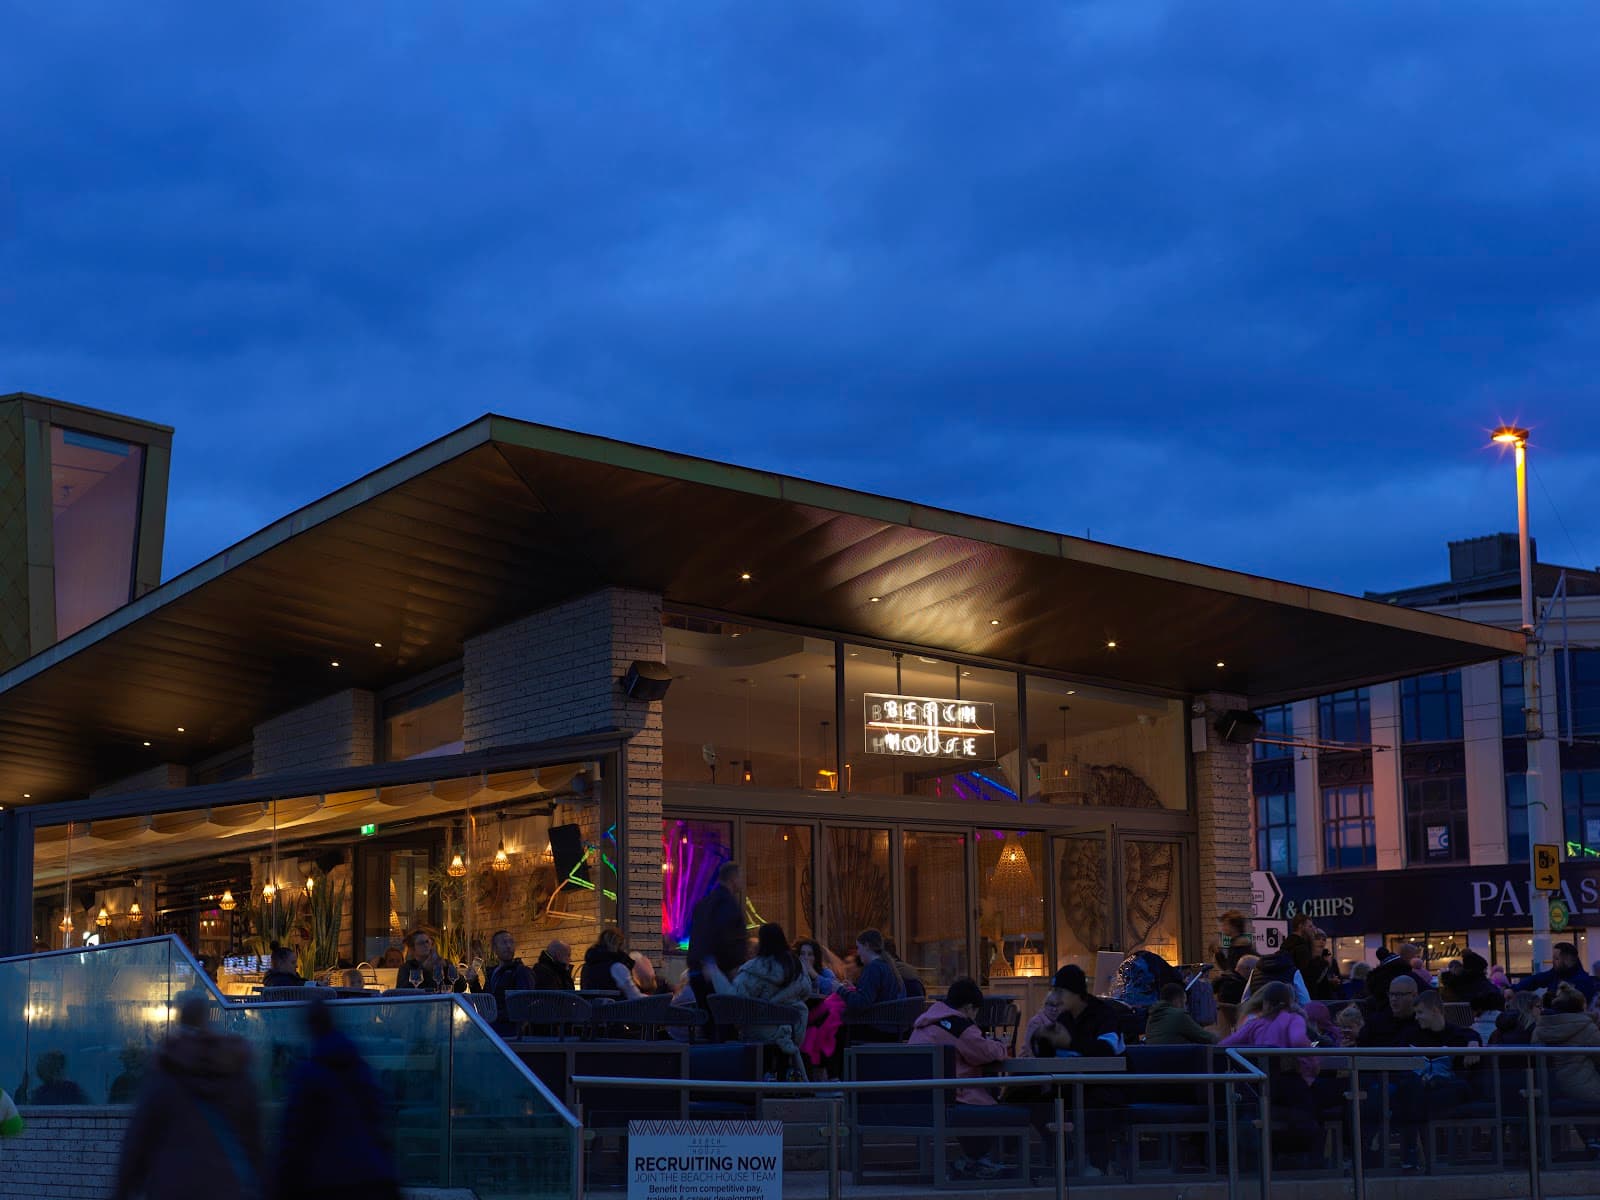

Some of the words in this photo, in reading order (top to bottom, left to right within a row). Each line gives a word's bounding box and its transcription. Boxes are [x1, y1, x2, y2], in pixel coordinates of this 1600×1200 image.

[883, 700, 976, 723] BEACH
[883, 731, 977, 756] HOUSE
[1286, 900, 1298, 919] &
[1302, 896, 1355, 918] CHIPS
[635, 1156, 733, 1171] RECRUITING
[738, 1156, 777, 1171] NOW
[634, 1172, 657, 1182] JOIN
[660, 1172, 678, 1182] THE
[680, 1172, 713, 1182] BEACH
[716, 1171, 749, 1181] HOUSE
[751, 1171, 777, 1181] TEAM
[649, 1184, 678, 1193] Benefit
[679, 1184, 698, 1193] from
[700, 1184, 745, 1195] competitive
